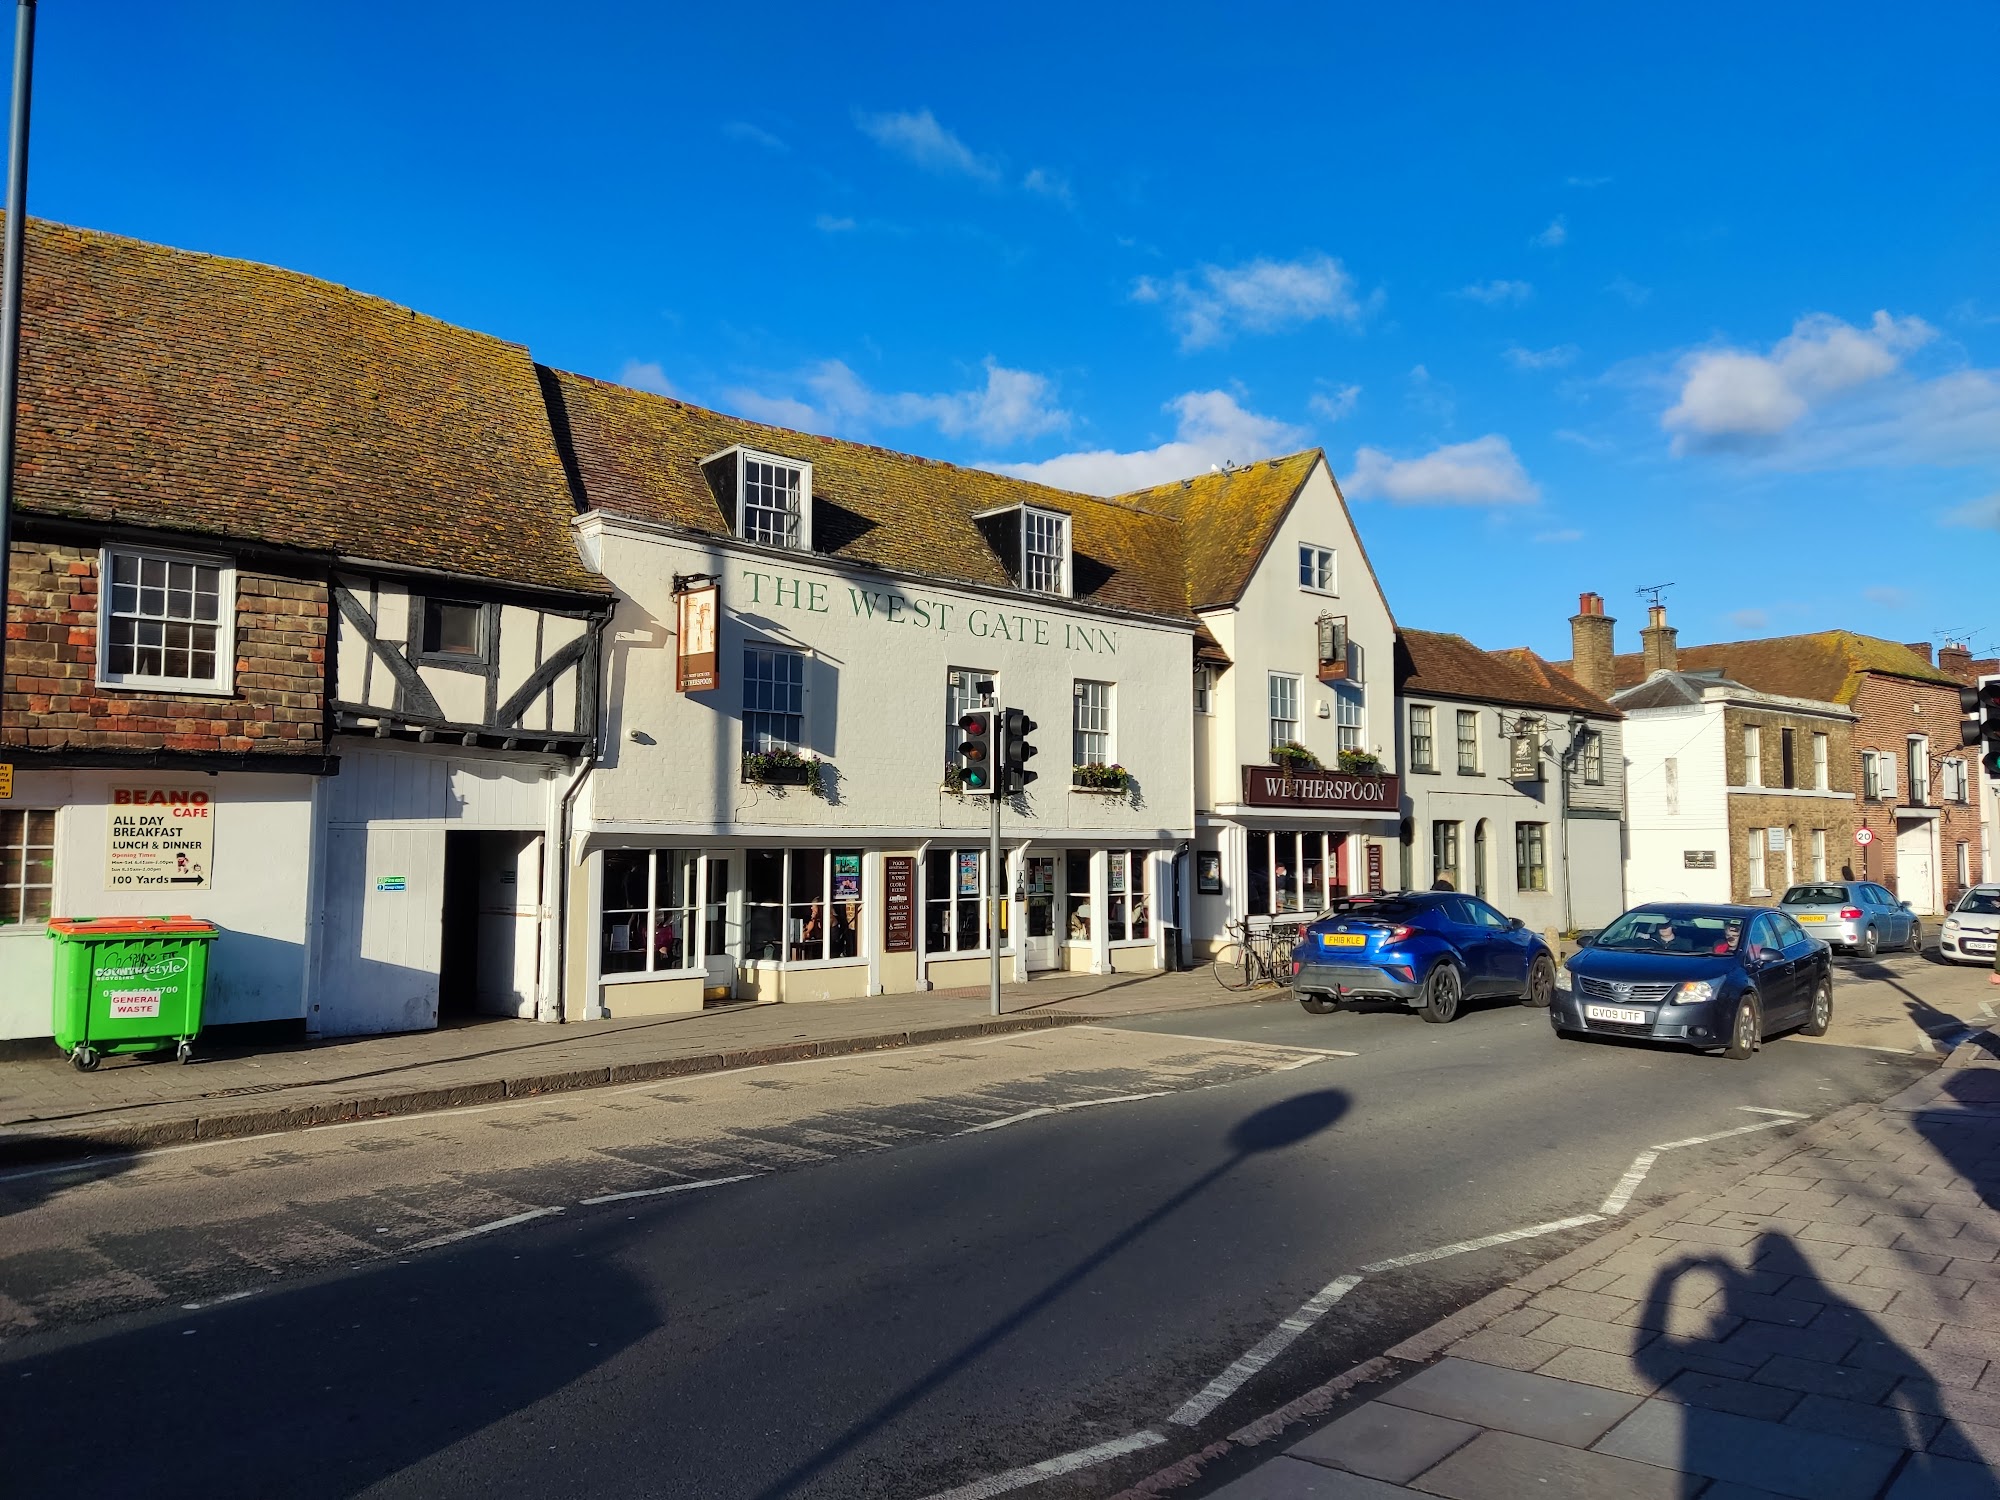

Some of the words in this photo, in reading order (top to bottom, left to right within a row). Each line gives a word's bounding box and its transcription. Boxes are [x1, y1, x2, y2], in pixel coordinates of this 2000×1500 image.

[742, 570, 831, 614] THE
[847, 587, 955, 631] WEST
[968, 608, 1050, 646] GATE
[1065, 623, 1119, 656] INN
[1264, 777, 1387, 801] WETHERSPOON
[113, 789, 210, 807] BEANO
[172, 808, 208, 818] CAFE
[113, 816, 136, 826] ALL
[139, 816, 165, 826] DAY
[113, 827, 184, 837] BREAKFAST
[1857, 832, 1871, 841] 20
[112, 841, 149, 850] LUNCH
[151, 841, 160, 850] &
[162, 841, 203, 850] DINNER
[112, 874, 133, 884] 100
[136, 874, 169, 884] Yards
[1346, 936, 1361, 944] KLE
[112, 996, 160, 1004] GENERAL
[117, 1005, 153, 1013] WASTE
[1592, 1007, 1618, 1019] GV09
[1620, 1011, 1641, 1021] UTF
